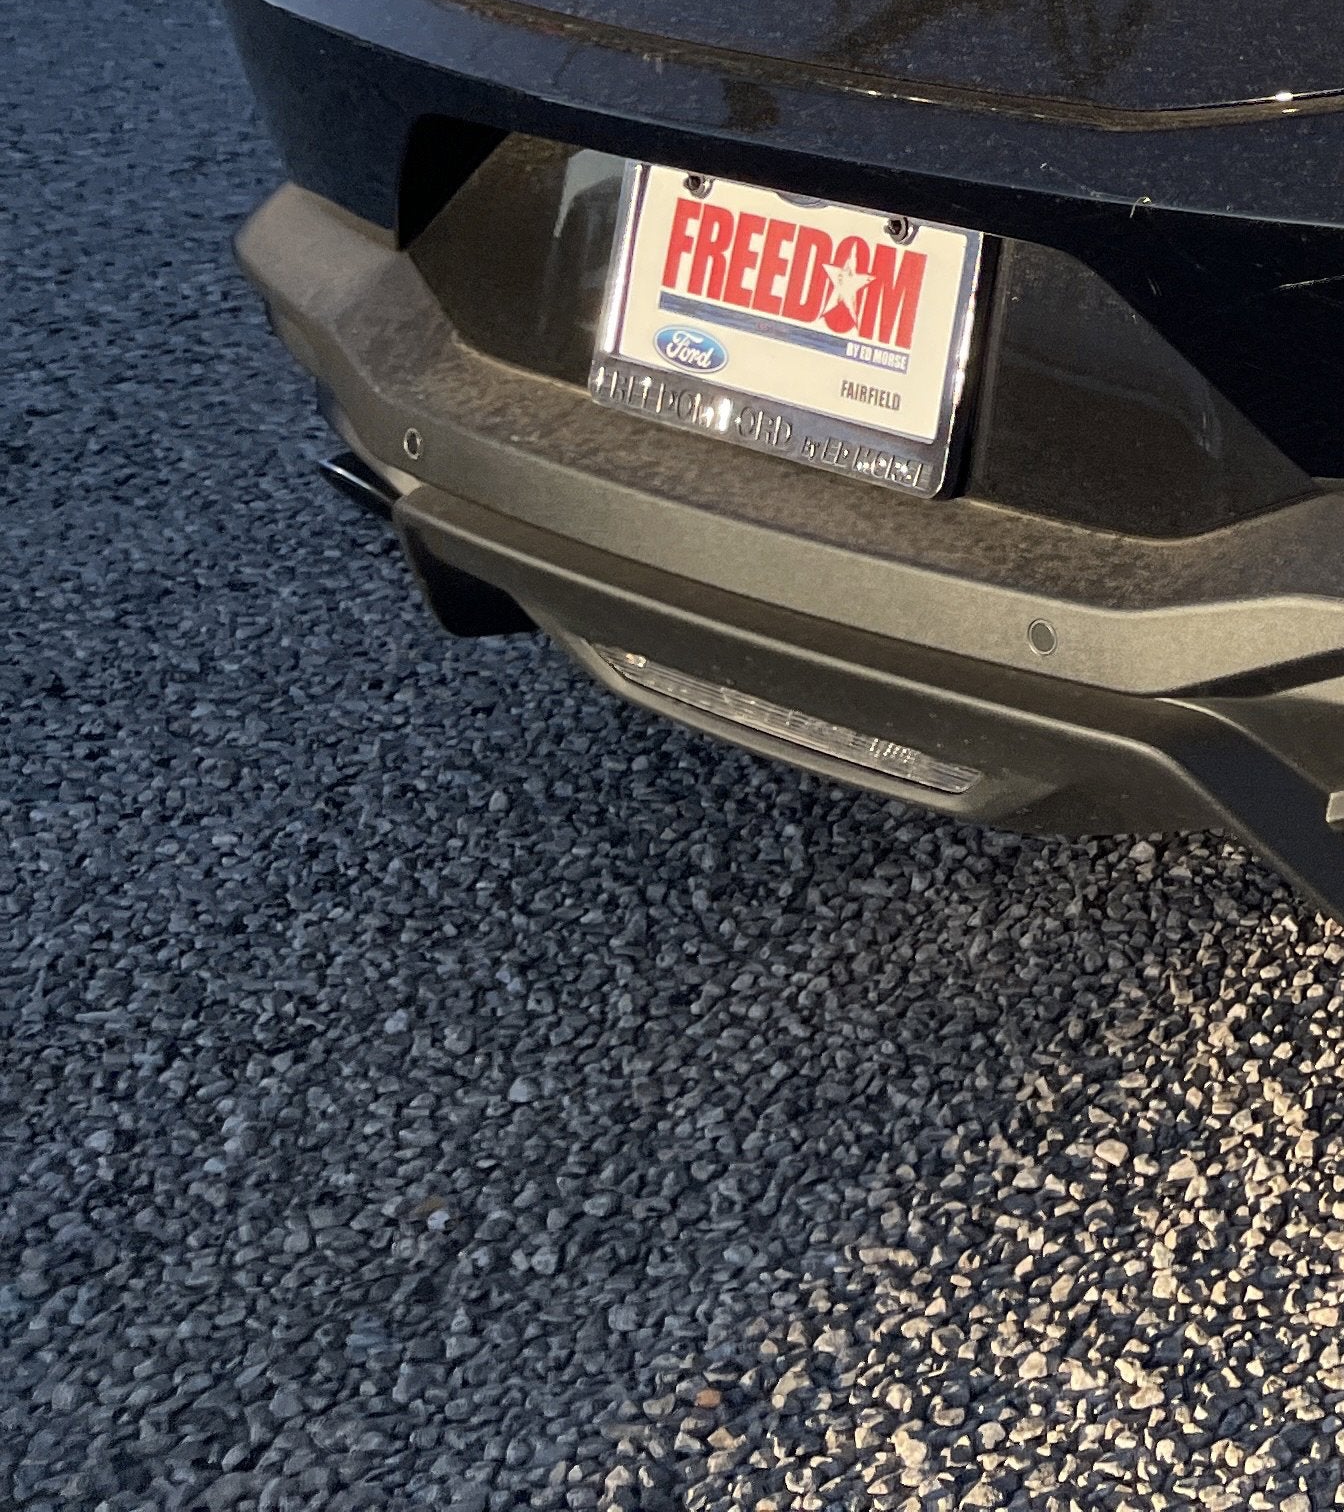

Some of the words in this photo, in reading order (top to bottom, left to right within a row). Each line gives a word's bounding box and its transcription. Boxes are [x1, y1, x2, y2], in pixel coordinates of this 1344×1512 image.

[661, 197, 928, 350] FREEDOM
[665, 330, 714, 370] Ford
[846, 342, 860, 358] BY
[860, 345, 873, 361] ED
[872, 349, 908, 370] MORSE
[840, 379, 902, 411] FAIRFIELD
